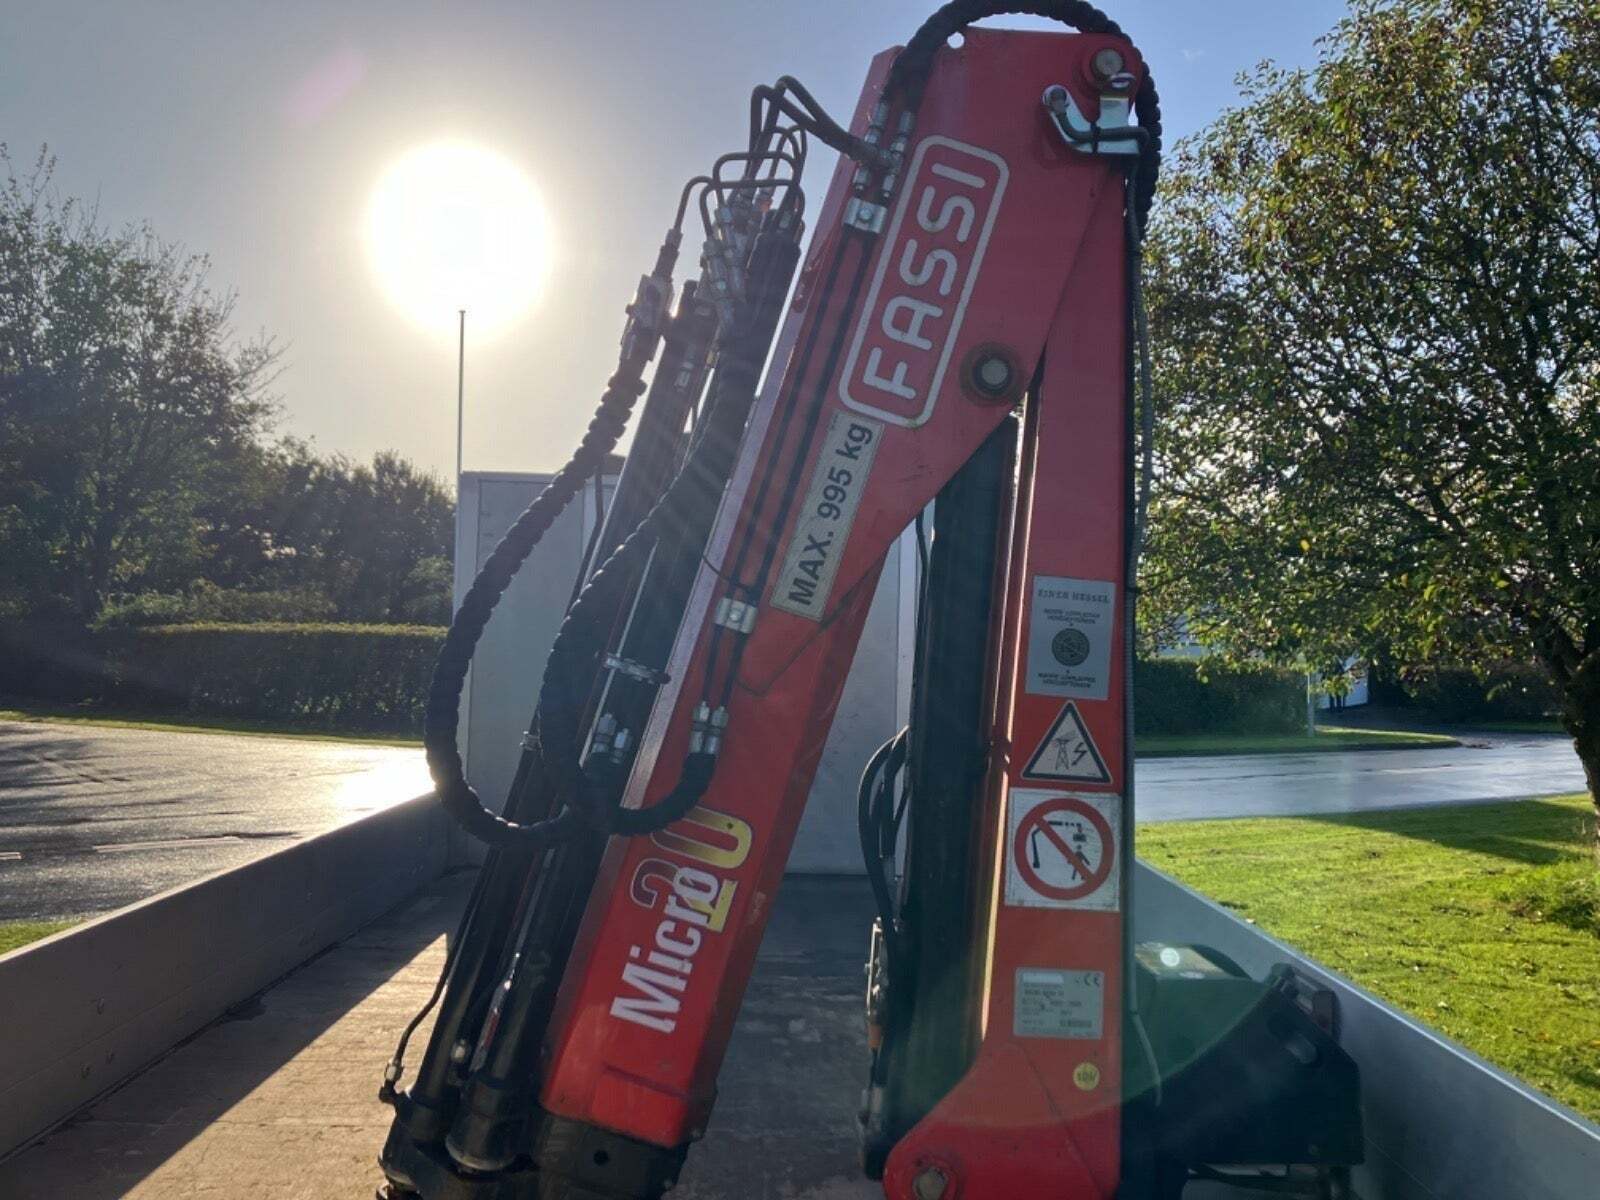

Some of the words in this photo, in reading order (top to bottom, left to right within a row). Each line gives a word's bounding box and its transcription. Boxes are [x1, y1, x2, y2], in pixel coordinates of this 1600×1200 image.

[863, 162, 986, 399] FASSI
[788, 531, 834, 606] MAX.
[817, 466, 853, 520] 995
[835, 423, 873, 460] kg
[609, 867, 719, 1034] Micro
